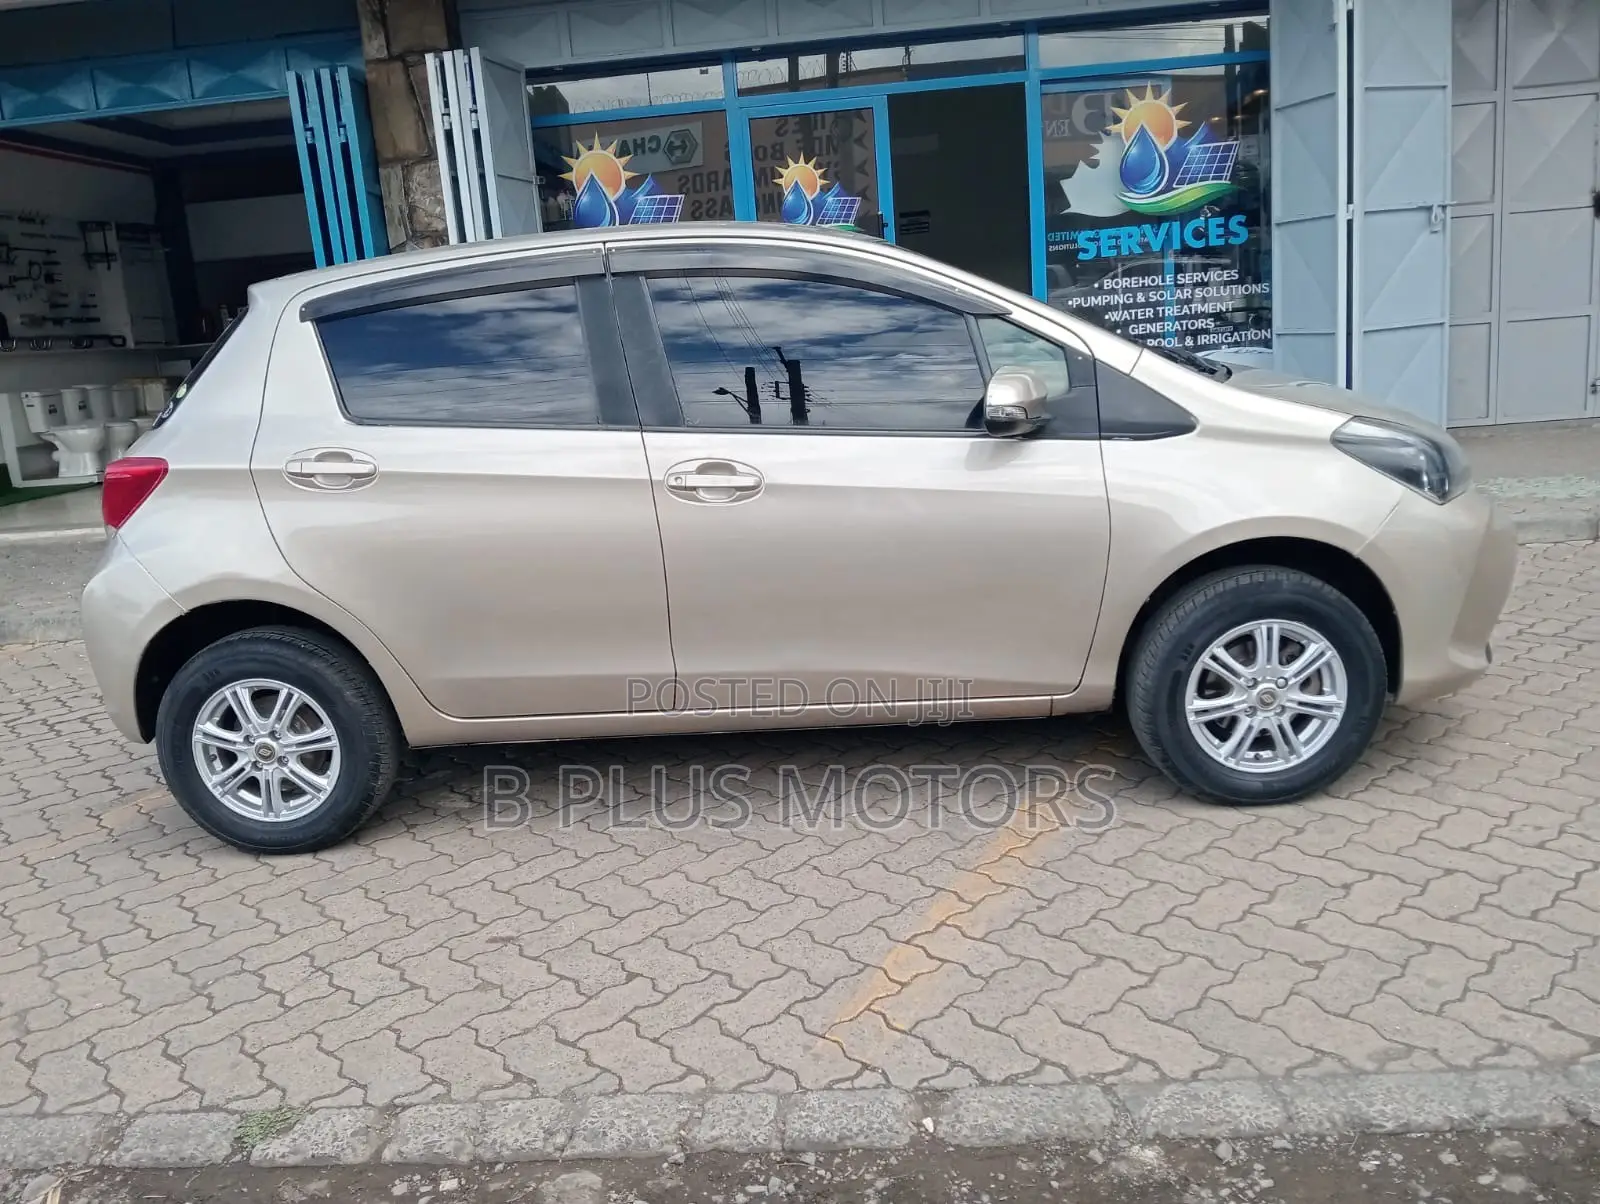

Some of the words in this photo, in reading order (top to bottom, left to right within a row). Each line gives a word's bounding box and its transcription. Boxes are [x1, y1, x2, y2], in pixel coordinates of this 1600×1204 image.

[1077, 214, 1249, 261] SERVICES
[1103, 274, 1175, 290] BOREHOLE
[1176, 269, 1239, 285] SERVICES
[1072, 294, 1133, 308] PUMPING
[1136, 292, 1146, 303] &
[1149, 288, 1192, 302] SOLAR
[1195, 283, 1270, 298] SOLUTIONS
[1108, 307, 1154, 322] WATER
[1156, 301, 1235, 317] TREATMENT
[1128, 318, 1215, 335] GENERATORS
[1185, 335, 1194, 347] &
[1197, 328, 1271, 345] IRRIGATION
